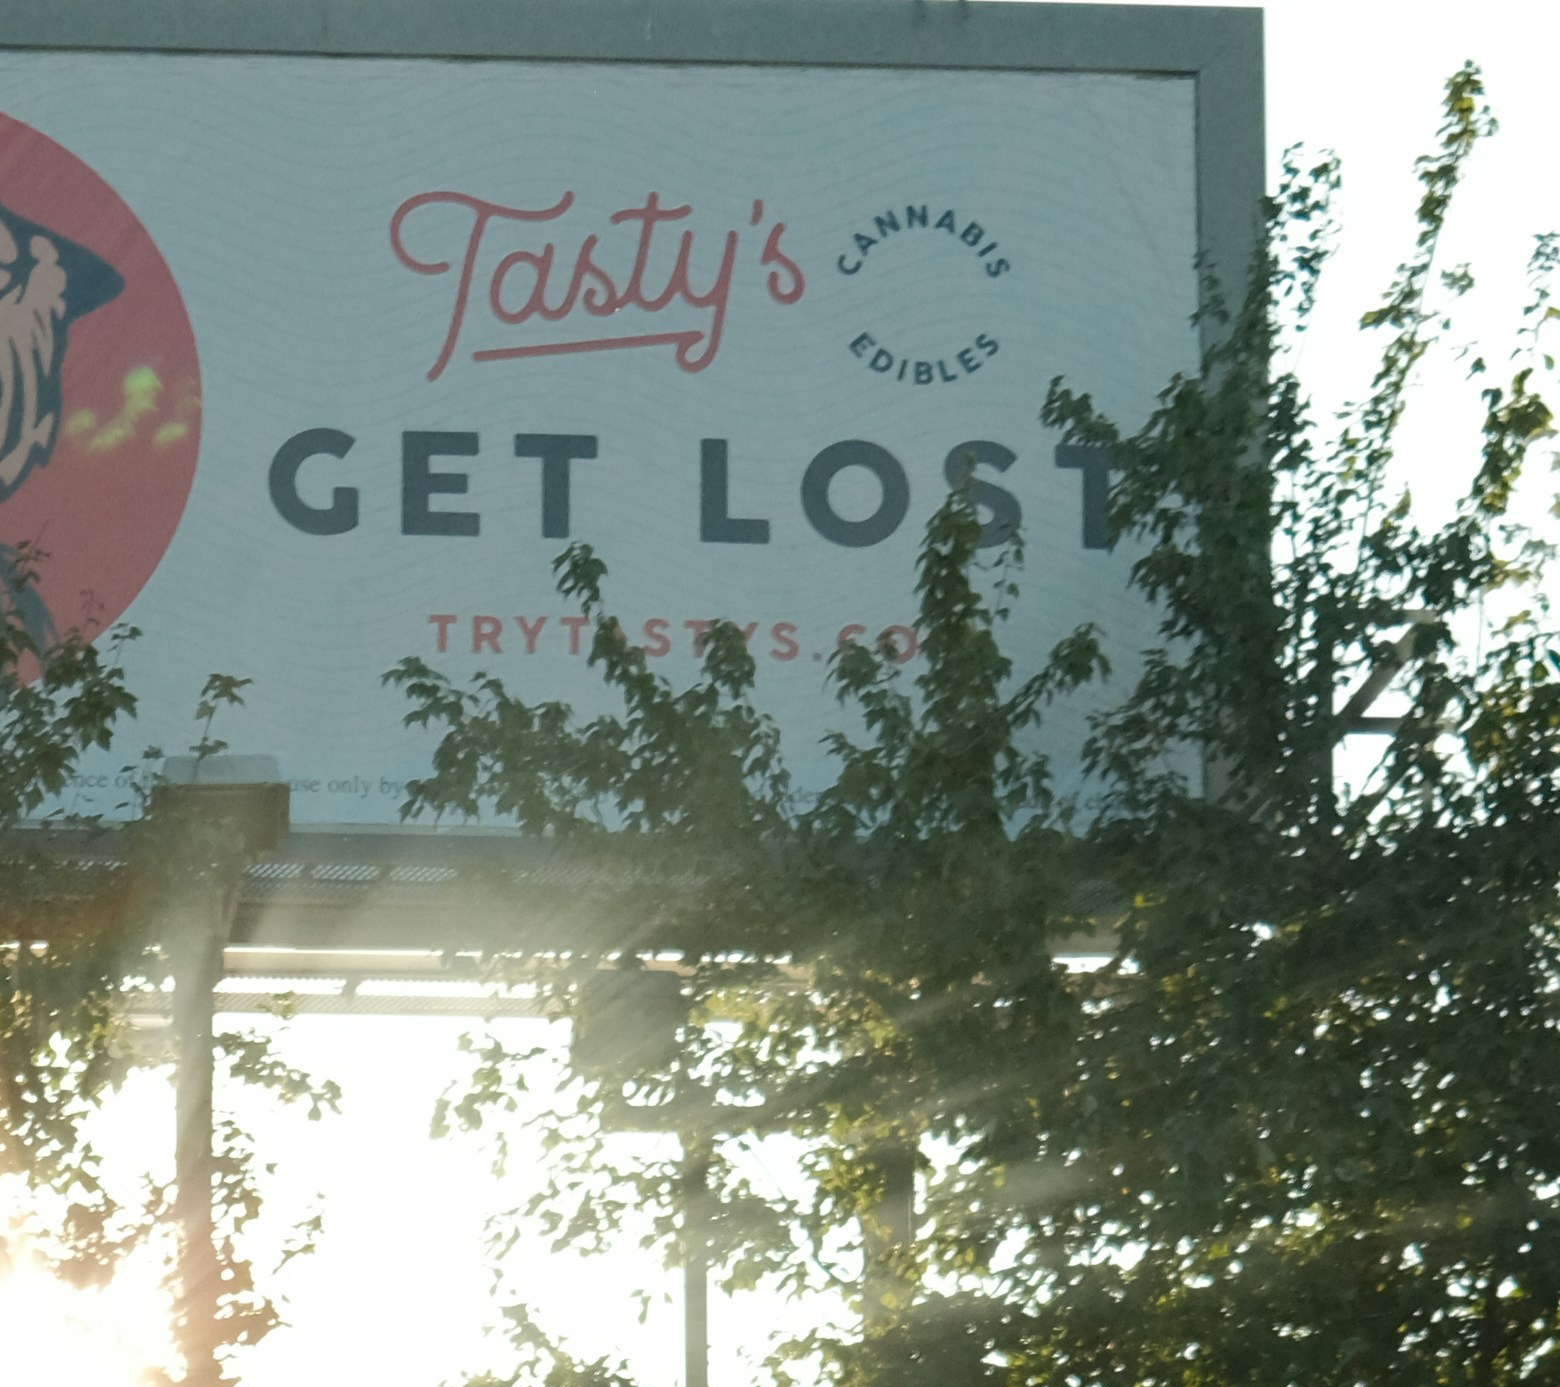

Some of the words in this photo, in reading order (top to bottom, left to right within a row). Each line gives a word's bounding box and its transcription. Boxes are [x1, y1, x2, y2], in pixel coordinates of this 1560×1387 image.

[836, 204, 1011, 279] CANNABIS
[389, 190, 806, 383] Tasty's
[848, 331, 1001, 386] EDIBLES
[268, 427, 599, 539] GET
[698, 436, 1132, 550] LOST
[428, 613, 924, 666] TRYTSTS.CO
[327, 775, 372, 799] only
[380, 774, 408, 800] by
